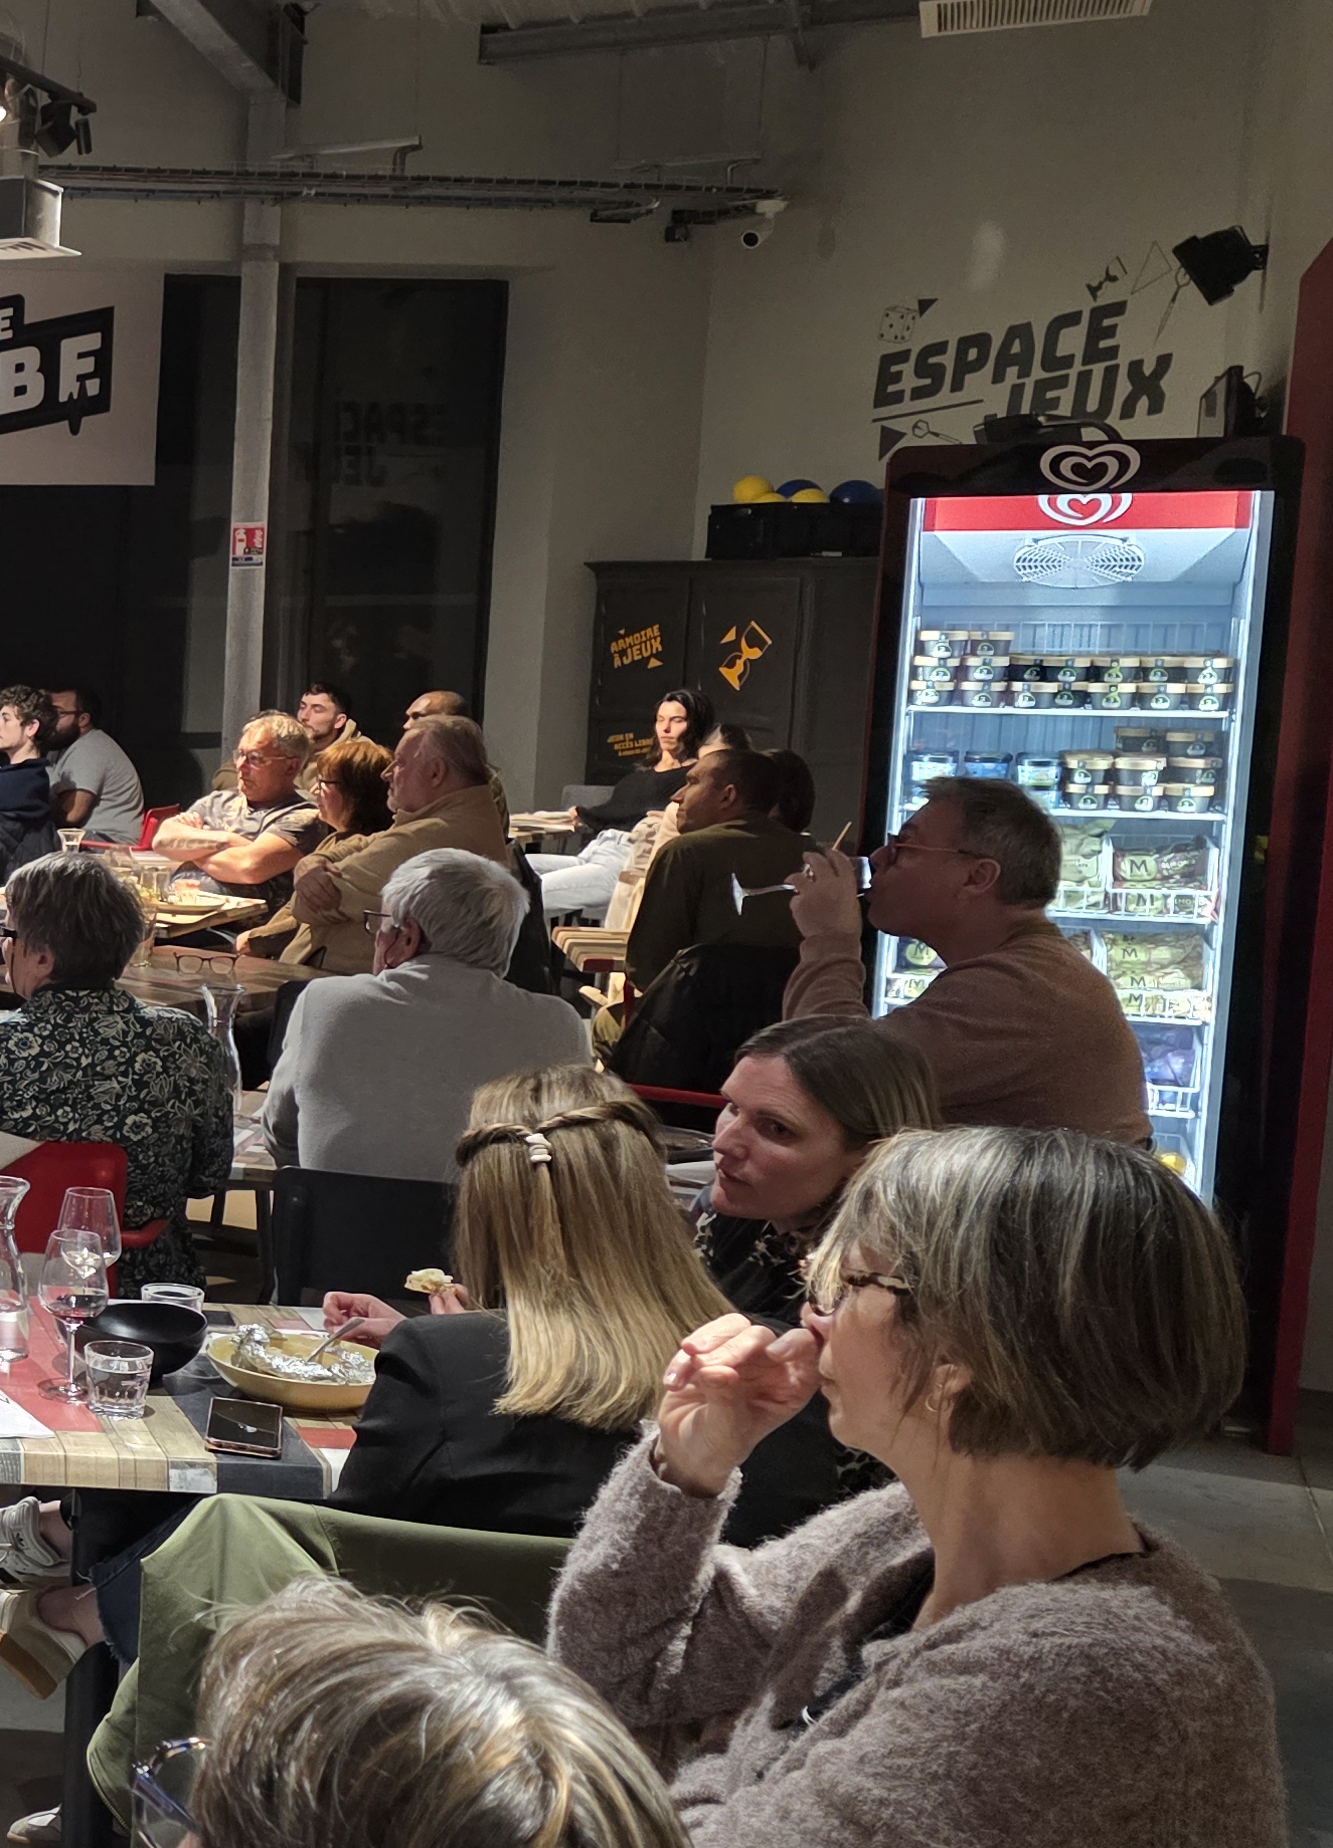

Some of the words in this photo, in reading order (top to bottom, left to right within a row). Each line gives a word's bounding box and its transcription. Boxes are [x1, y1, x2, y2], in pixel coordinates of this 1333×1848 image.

[873, 300, 1128, 409] ESPACE
[610, 624, 661, 653] ARMOIRE
[622, 636, 663, 665] JEUX
